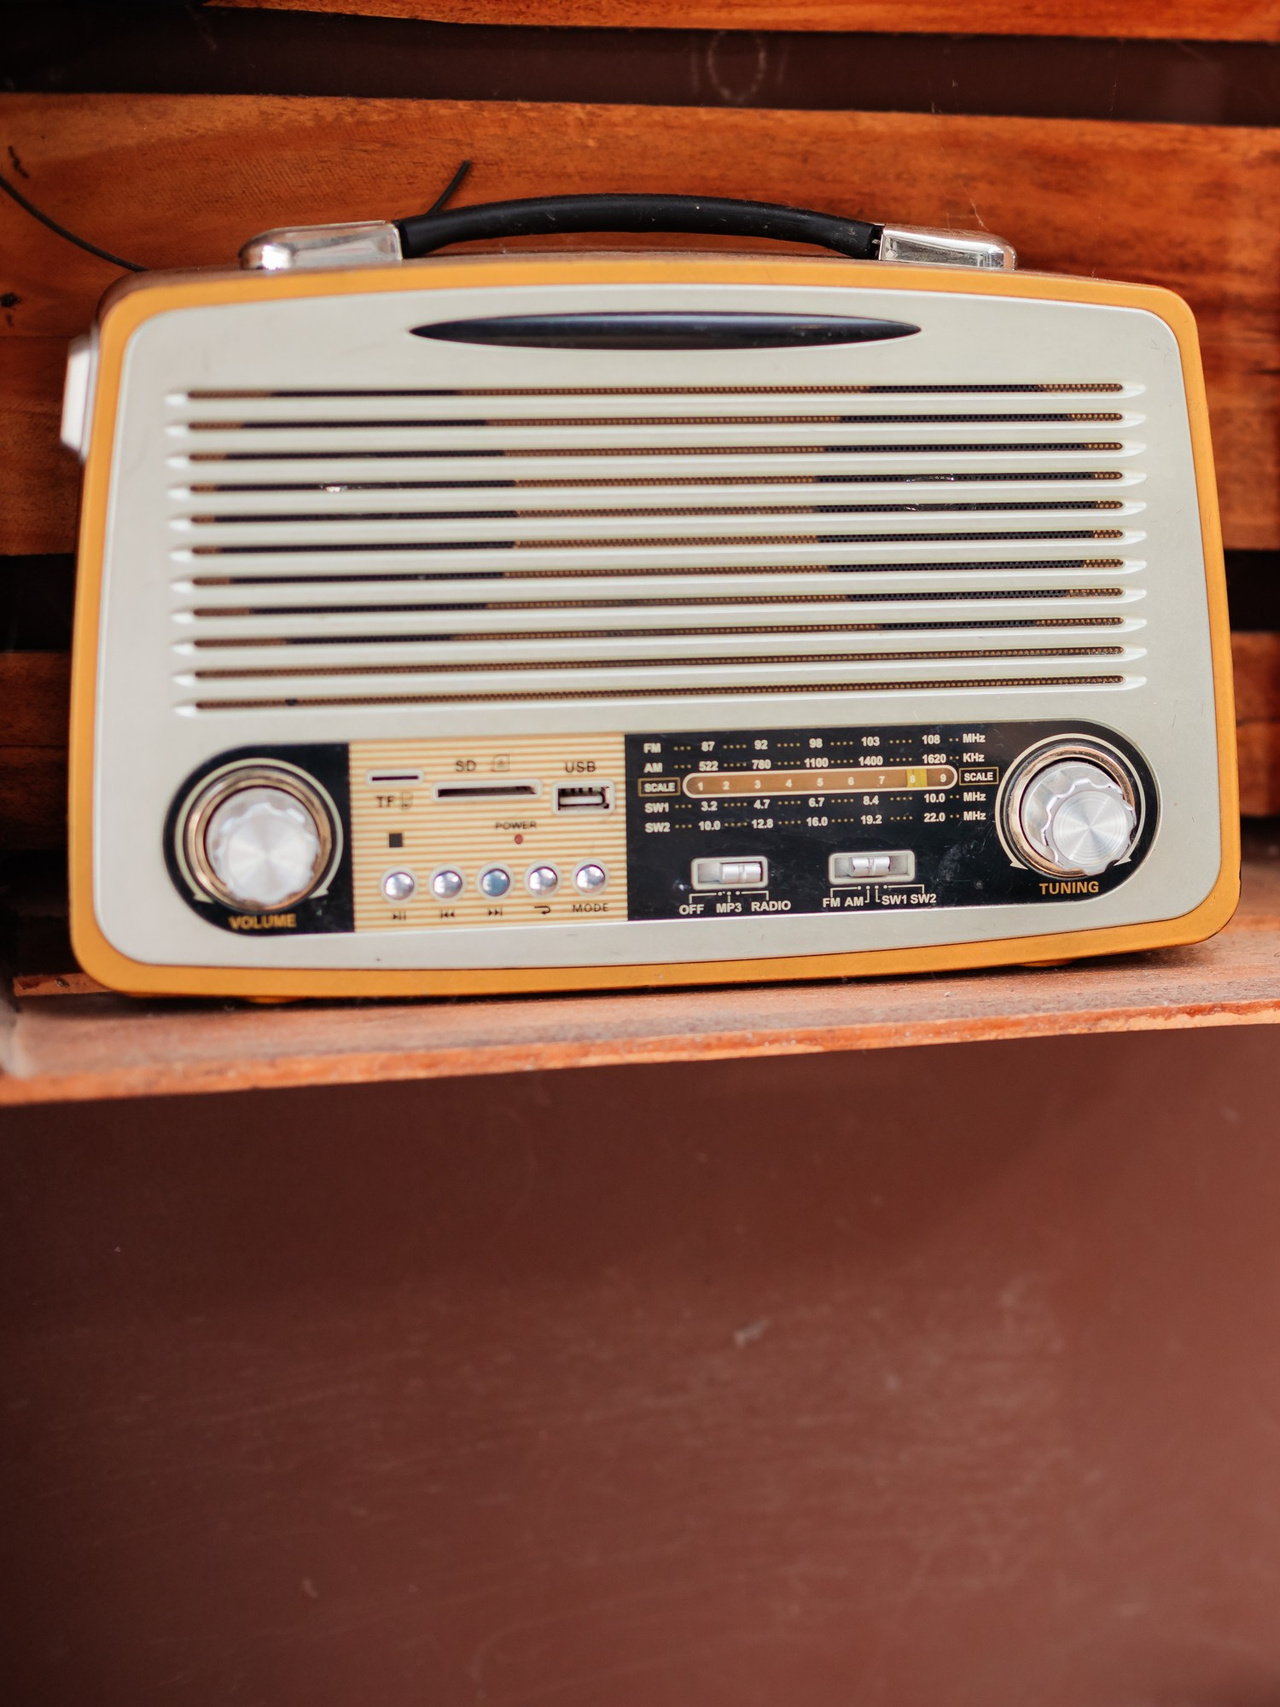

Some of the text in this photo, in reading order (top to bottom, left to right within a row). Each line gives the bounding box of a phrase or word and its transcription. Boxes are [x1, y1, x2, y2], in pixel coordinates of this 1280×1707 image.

[643, 733, 986, 753] FM 87 92 98 103 108 MHz
[455, 760, 476, 773] SD
[564, 761, 597, 773] USB
[644, 753, 985, 773] AM 522 780 1100 1400 1620 KHz
[644, 772, 993, 793] SCALE 1 2 3 4 5 6 7 8 9 SCALE
[376, 796, 395, 808] TF
[645, 792, 986, 813] SW1 3.2 4.7 6.7 8.4 10.0 MHz
[495, 821, 537, 829] POWER
[645, 811, 986, 833] SW2 10.0 12.8 16.0 19.2 22.0 MHz
[1039, 881, 1099, 895] TUNING
[823, 893, 937, 907] FM AM SW1 SW2
[572, 903, 609, 913] MODE
[679, 900, 791, 915] OFF MP3 RADIO
[228, 913, 297, 929] VOLUME
